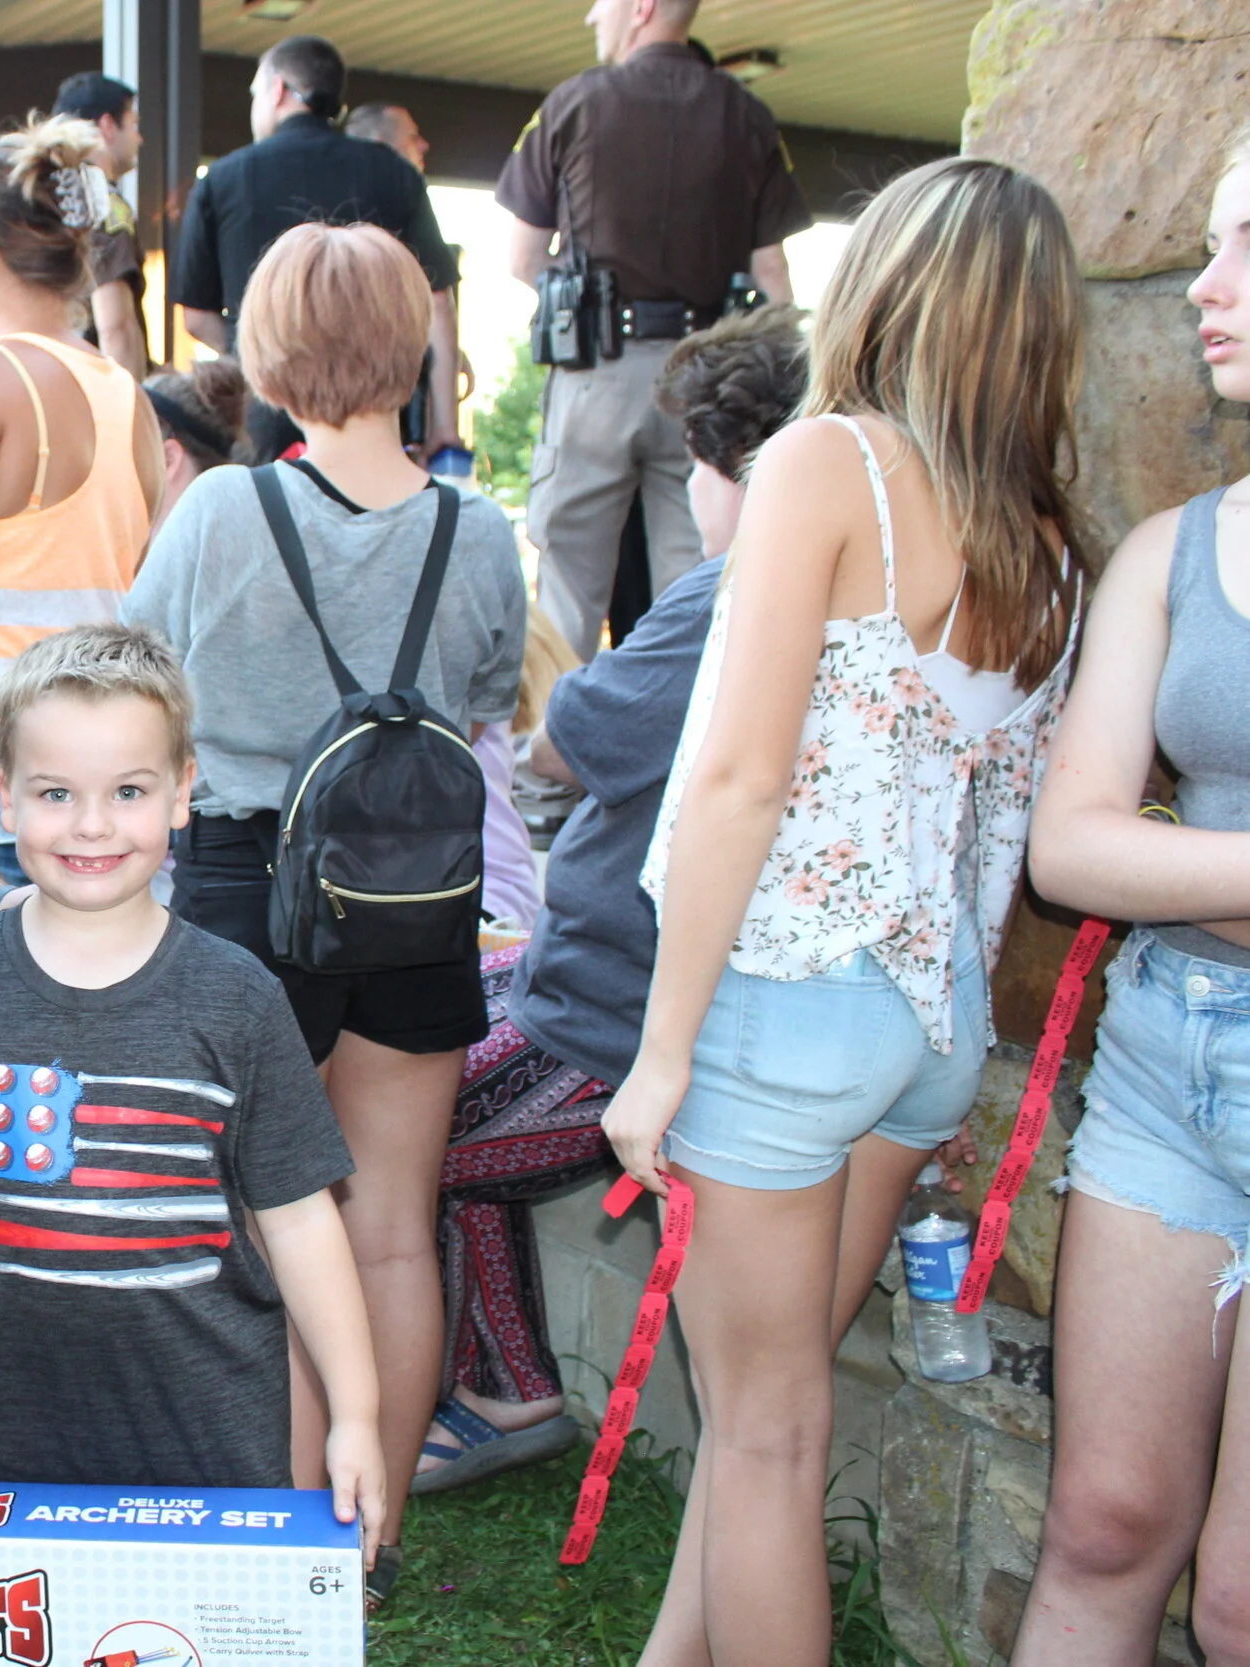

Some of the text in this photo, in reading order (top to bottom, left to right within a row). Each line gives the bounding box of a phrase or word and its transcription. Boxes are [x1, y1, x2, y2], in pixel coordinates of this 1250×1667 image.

[1070, 938, 1085, 962] KEEP
[1078, 935, 1100, 971] COUPON
[1052, 995, 1063, 1021] KEEP
[1060, 991, 1077, 1030] COUPON
[1033, 1053, 1046, 1080] KEEP
[1042, 1050, 1059, 1088] COUPON
[1016, 1112, 1029, 1137] KEEP
[1026, 1107, 1043, 1146] COUPON
[995, 1167, 1008, 1191] KEEP
[1003, 1164, 1024, 1198] COUPON
[667, 1208, 677, 1234] KEEP
[678, 1203, 689, 1241] COUPON
[980, 1221, 990, 1247] KEEP
[989, 1217, 1003, 1255] COUPON
[652, 1264, 663, 1285] KEEP
[661, 1260, 678, 1291] COUPON
[962, 1277, 972, 1300] KEEP
[970, 1272, 985, 1308] COUPON
[637, 1313, 647, 1335] KEEP
[646, 1308, 661, 1342] COUPON
[118, 1497, 204, 1509] DELUXE
[25, 1505, 291, 1528] ARCHERY SET
[312, 1566, 342, 1574] AGES
[309, 1575, 344, 1596] 6+
[194, 1603, 239, 1611] INCLUDES
[200, 1615, 285, 1625] Freestanding Target
[236, 1626, 280, 1635] Adjustable
[283, 1628, 302, 1636] Bow
[209, 1647, 232, 1656] Carry
[235, 1648, 263, 1656] Quiver
[286, 1649, 309, 1657] Strap
[211, 1636, 243, 1644] Suction
[246, 1637, 263, 1646] Cup
[265, 1638, 295, 1646] Arrows
